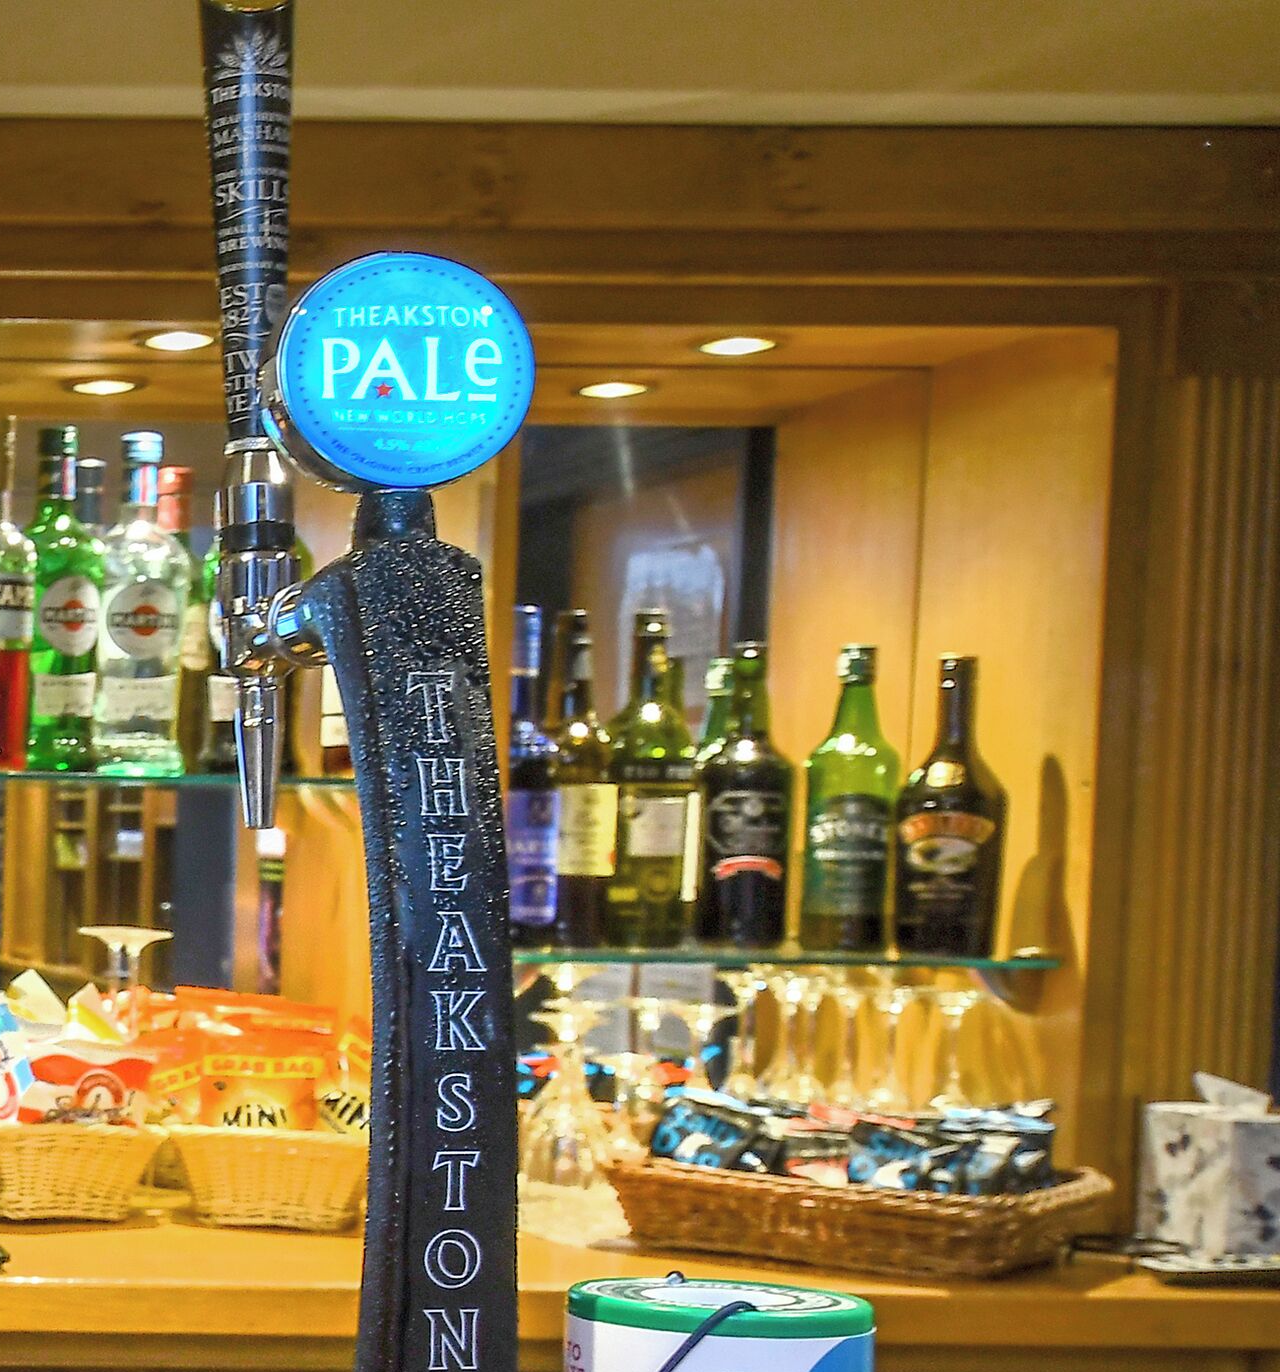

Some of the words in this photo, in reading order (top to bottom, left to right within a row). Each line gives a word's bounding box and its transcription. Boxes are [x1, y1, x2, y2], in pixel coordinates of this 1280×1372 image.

[211, 83, 291, 105] THEAKSTO
[213, 123, 290, 150] MASHA
[222, 307, 262, 330] 827
[334, 304, 490, 328] THEAKSTON
[405, 672, 488, 1371] THEAKSTON
